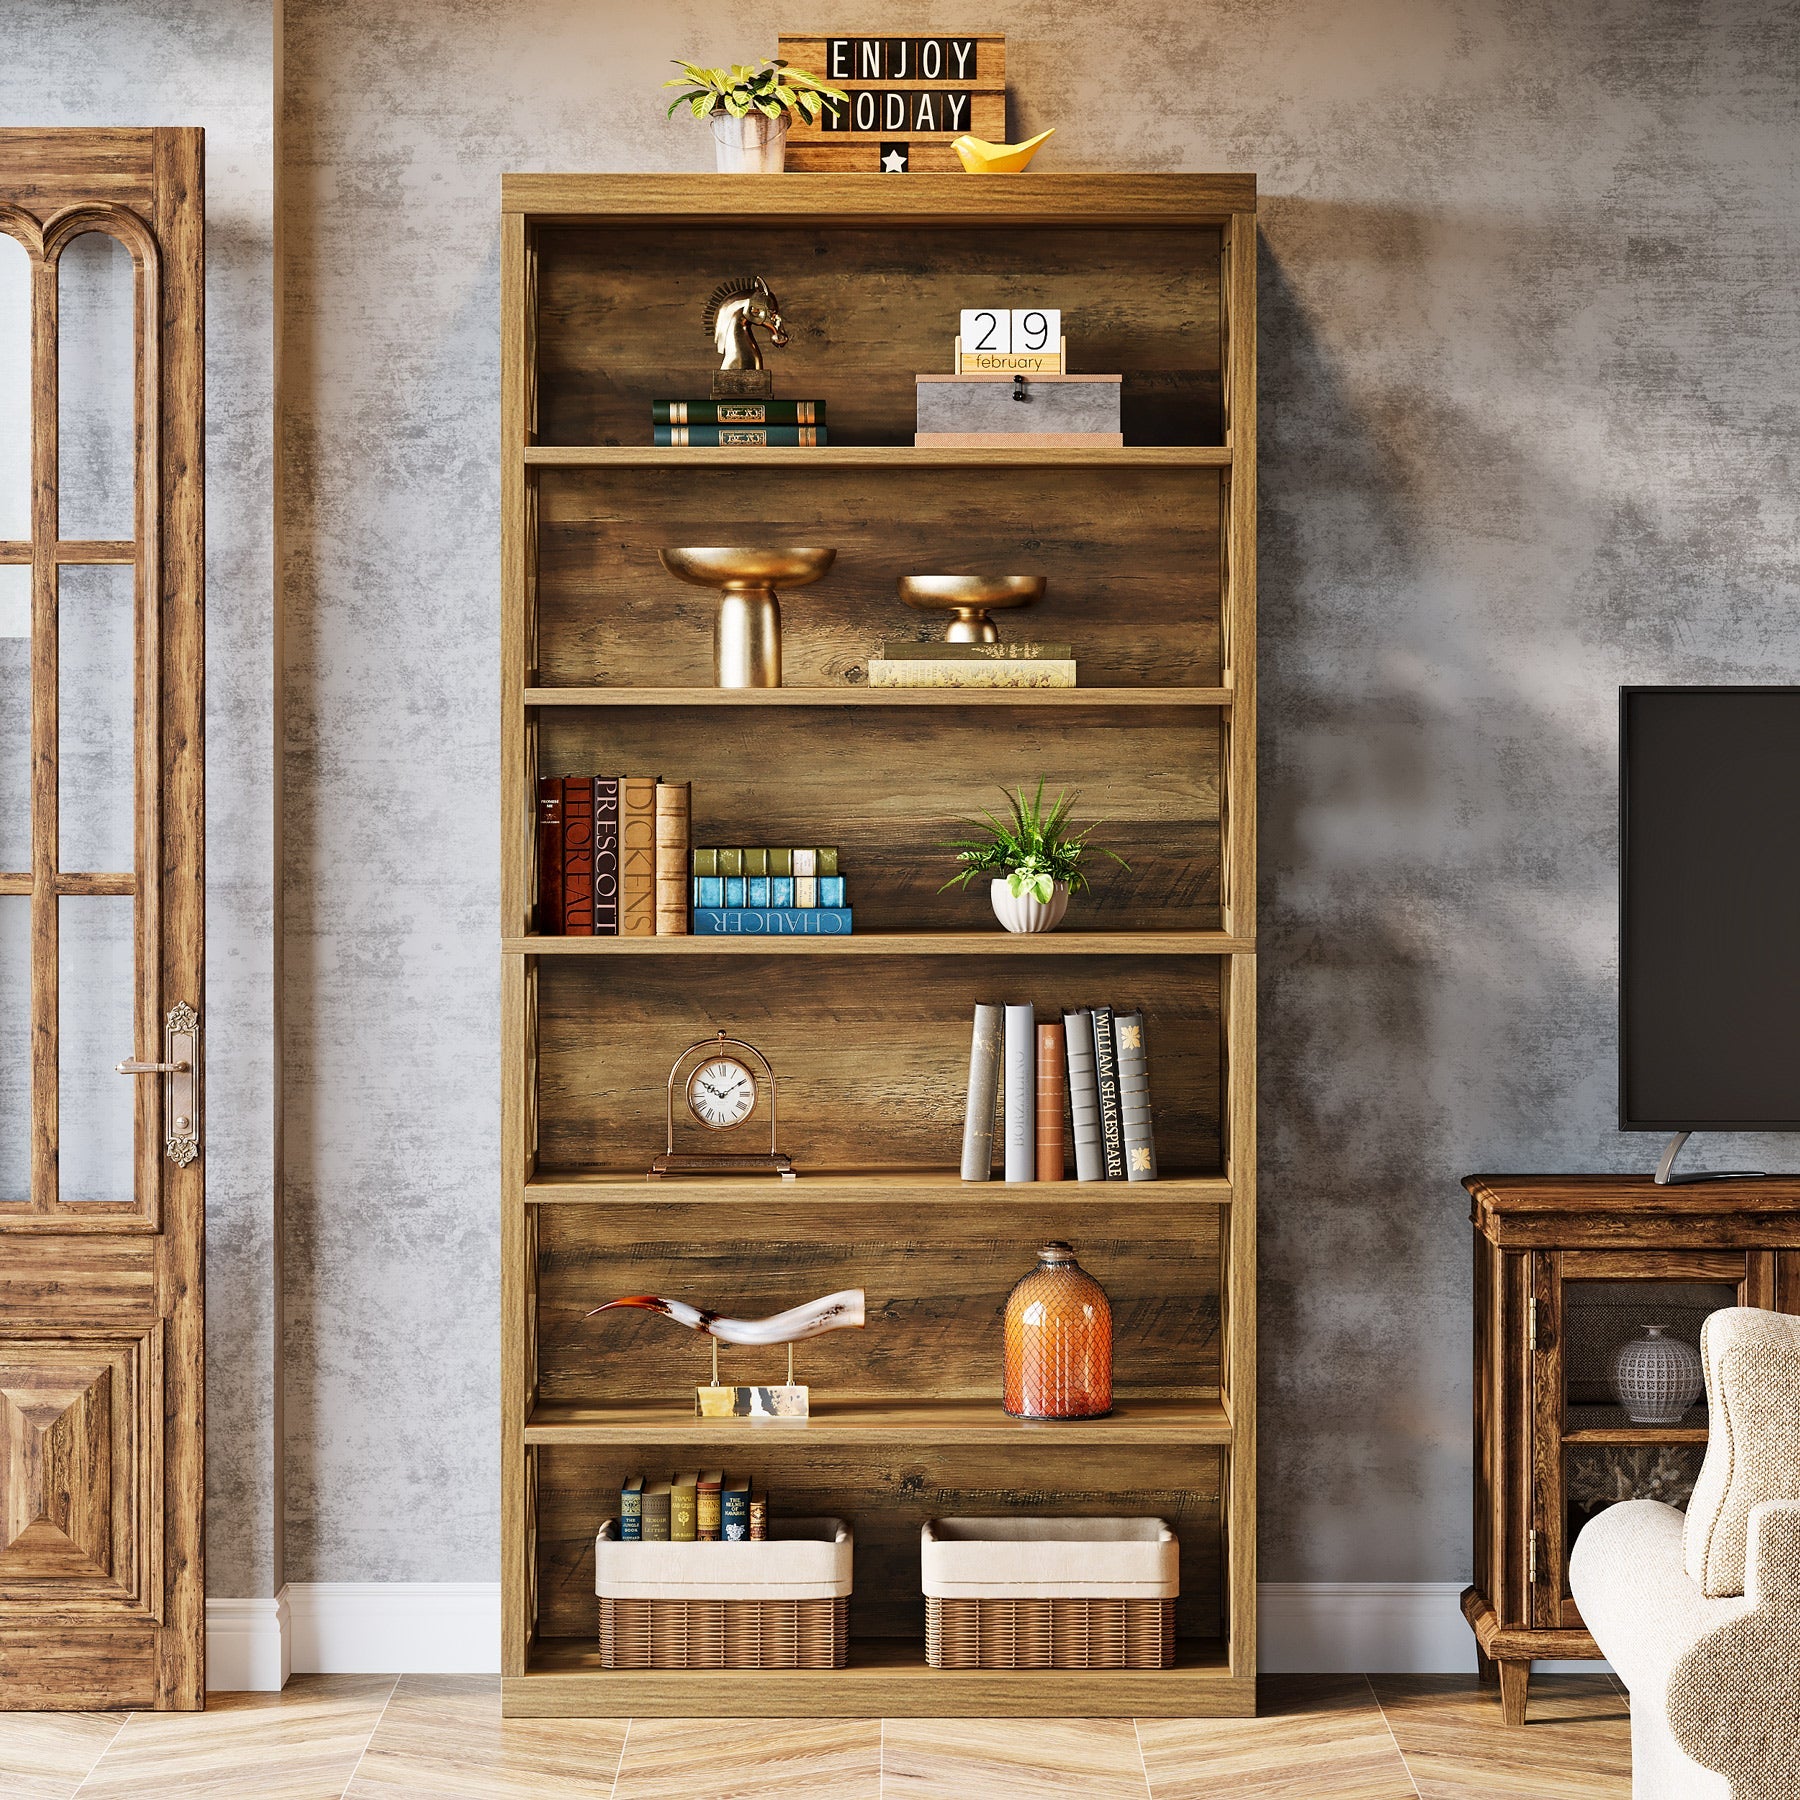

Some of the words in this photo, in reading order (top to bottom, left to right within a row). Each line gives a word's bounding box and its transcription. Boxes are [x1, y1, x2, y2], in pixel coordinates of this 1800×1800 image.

[833, 40, 972, 79] ENJOY
[827, 92, 966, 130] TODAY
[976, 354, 1043, 372] february
[565, 786, 592, 928] THOREAU
[596, 780, 618, 934] PRESCOTT
[624, 785, 653, 930] DICKENS
[710, 912, 842, 933] CHAUCER
[1096, 1012, 1113, 1078] WILLIAM
[1101, 1080, 1122, 1177] SHAKESPEARE
